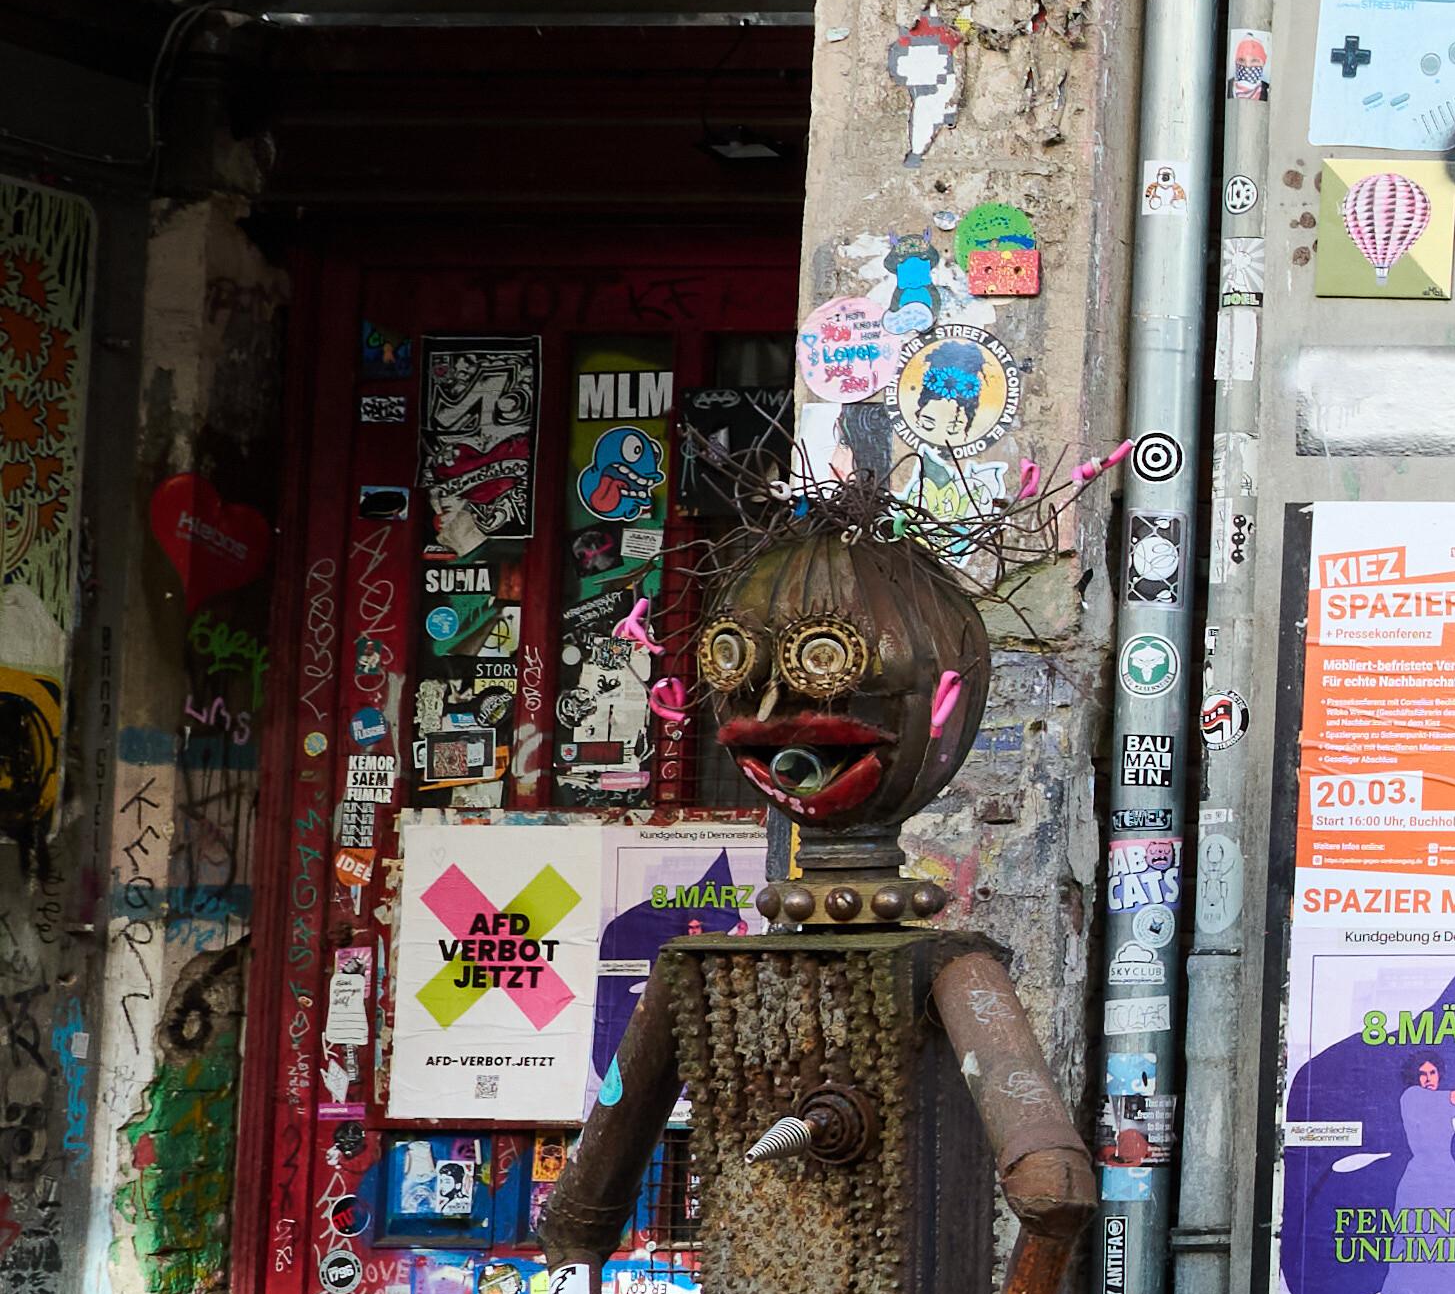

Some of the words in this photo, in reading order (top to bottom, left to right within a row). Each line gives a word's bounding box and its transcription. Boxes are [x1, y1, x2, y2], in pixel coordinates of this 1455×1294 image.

[935, 325, 988, 342] STREET
[988, 339, 1013, 364] ART
[578, 372, 673, 419] MLM
[1002, 367, 1020, 423] CONTRA
[952, 441, 987, 459] ODIO
[1324, 553, 1401, 587] KIEZ
[425, 568, 491, 593] SUMA
[1335, 628, 1432, 641] Pressekonferenz
[1323, 659, 1433, 673] Möbliert-befristete
[1322, 675, 1343, 688] Für
[1345, 675, 1376, 687] echte
[1126, 736, 1171, 752] BAU
[348, 755, 395, 771] KEMOR
[1125, 752, 1170, 769] MAL
[351, 771, 389, 787] SAEM
[1124, 769, 1170, 785] EIN.
[347, 788, 393, 804] FUMAR
[1316, 778, 1416, 807] 20.03.
[1316, 815, 1347, 828] Start
[1350, 815, 1381, 828] 16:00
[1384, 815, 1406, 830] Uhr,
[1108, 868, 1179, 911] CATS
[1303, 888, 1432, 914] SPAZIER
[469, 912, 531, 936] AFD
[1344, 930, 1430, 945] Kundgebung
[437, 939, 559, 963] VERBOT
[453, 965, 543, 990] JETZT
[425, 1054, 556, 1068] AFD-VERBOT.JETZT
[1107, 1236, 1123, 1288] ANTIFA
